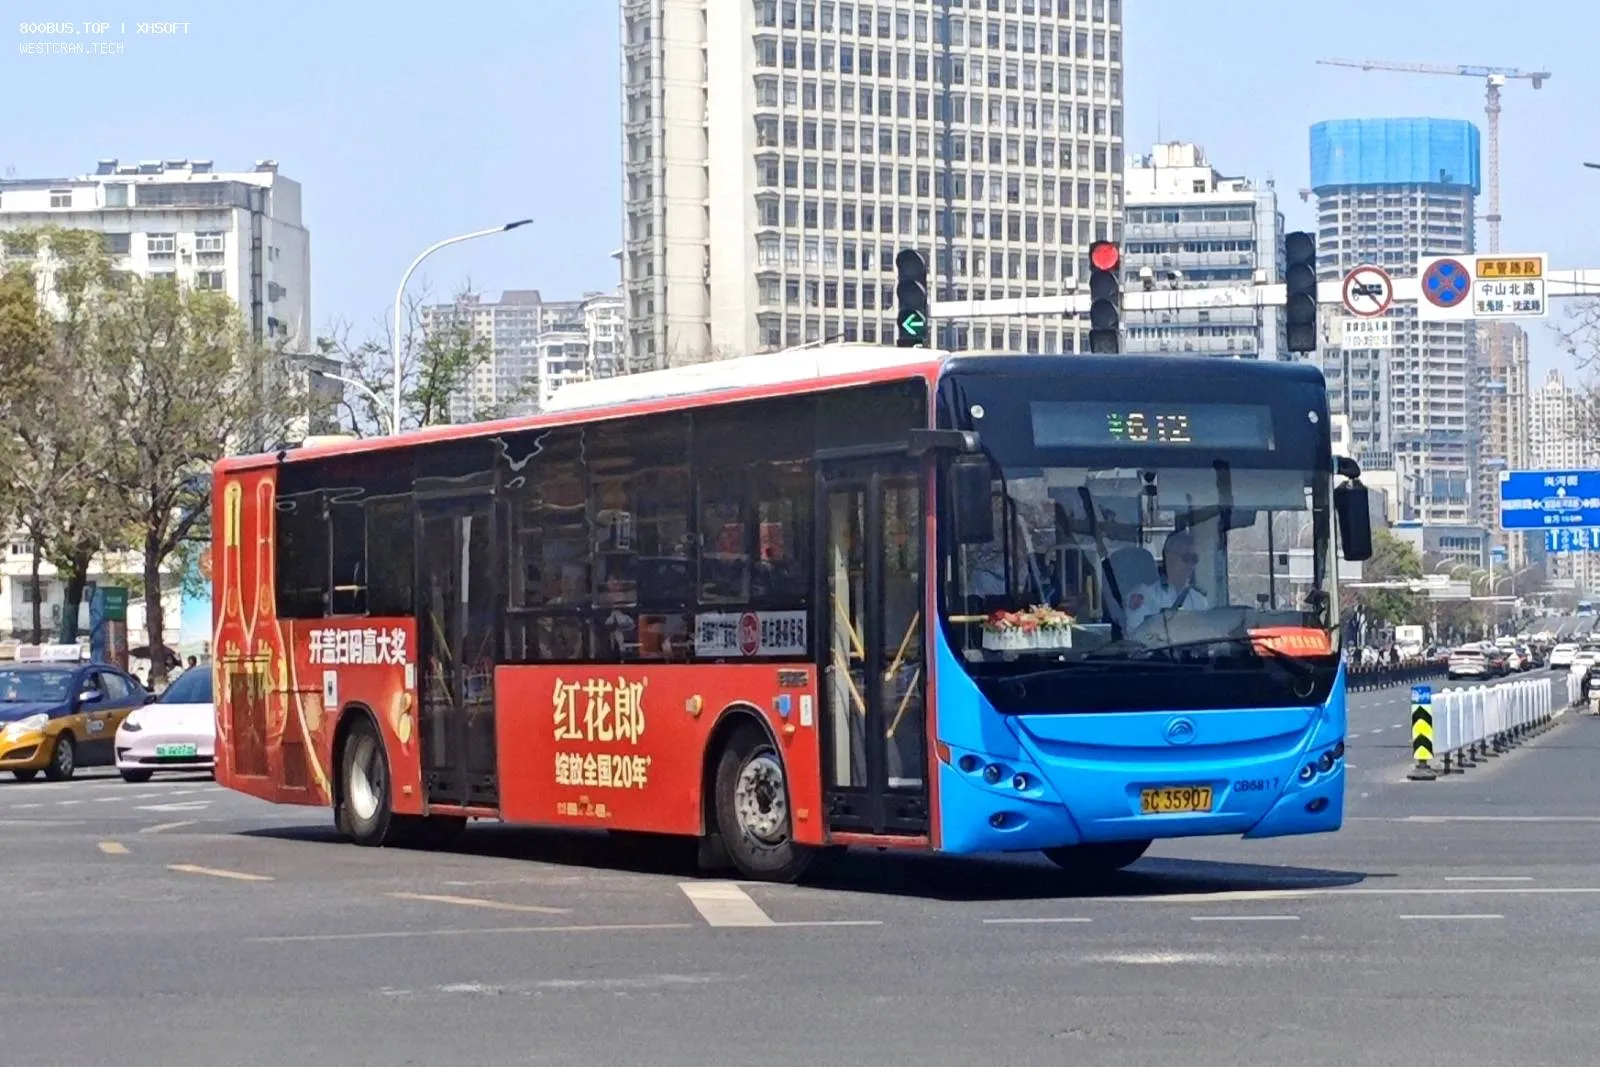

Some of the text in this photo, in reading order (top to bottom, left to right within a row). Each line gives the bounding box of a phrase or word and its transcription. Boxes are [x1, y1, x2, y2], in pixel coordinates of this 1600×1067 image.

[1482, 261, 1536, 275] 严管路段
[1481, 282, 1536, 296] 中山北路
[552, 675, 646, 745] 红花郎
